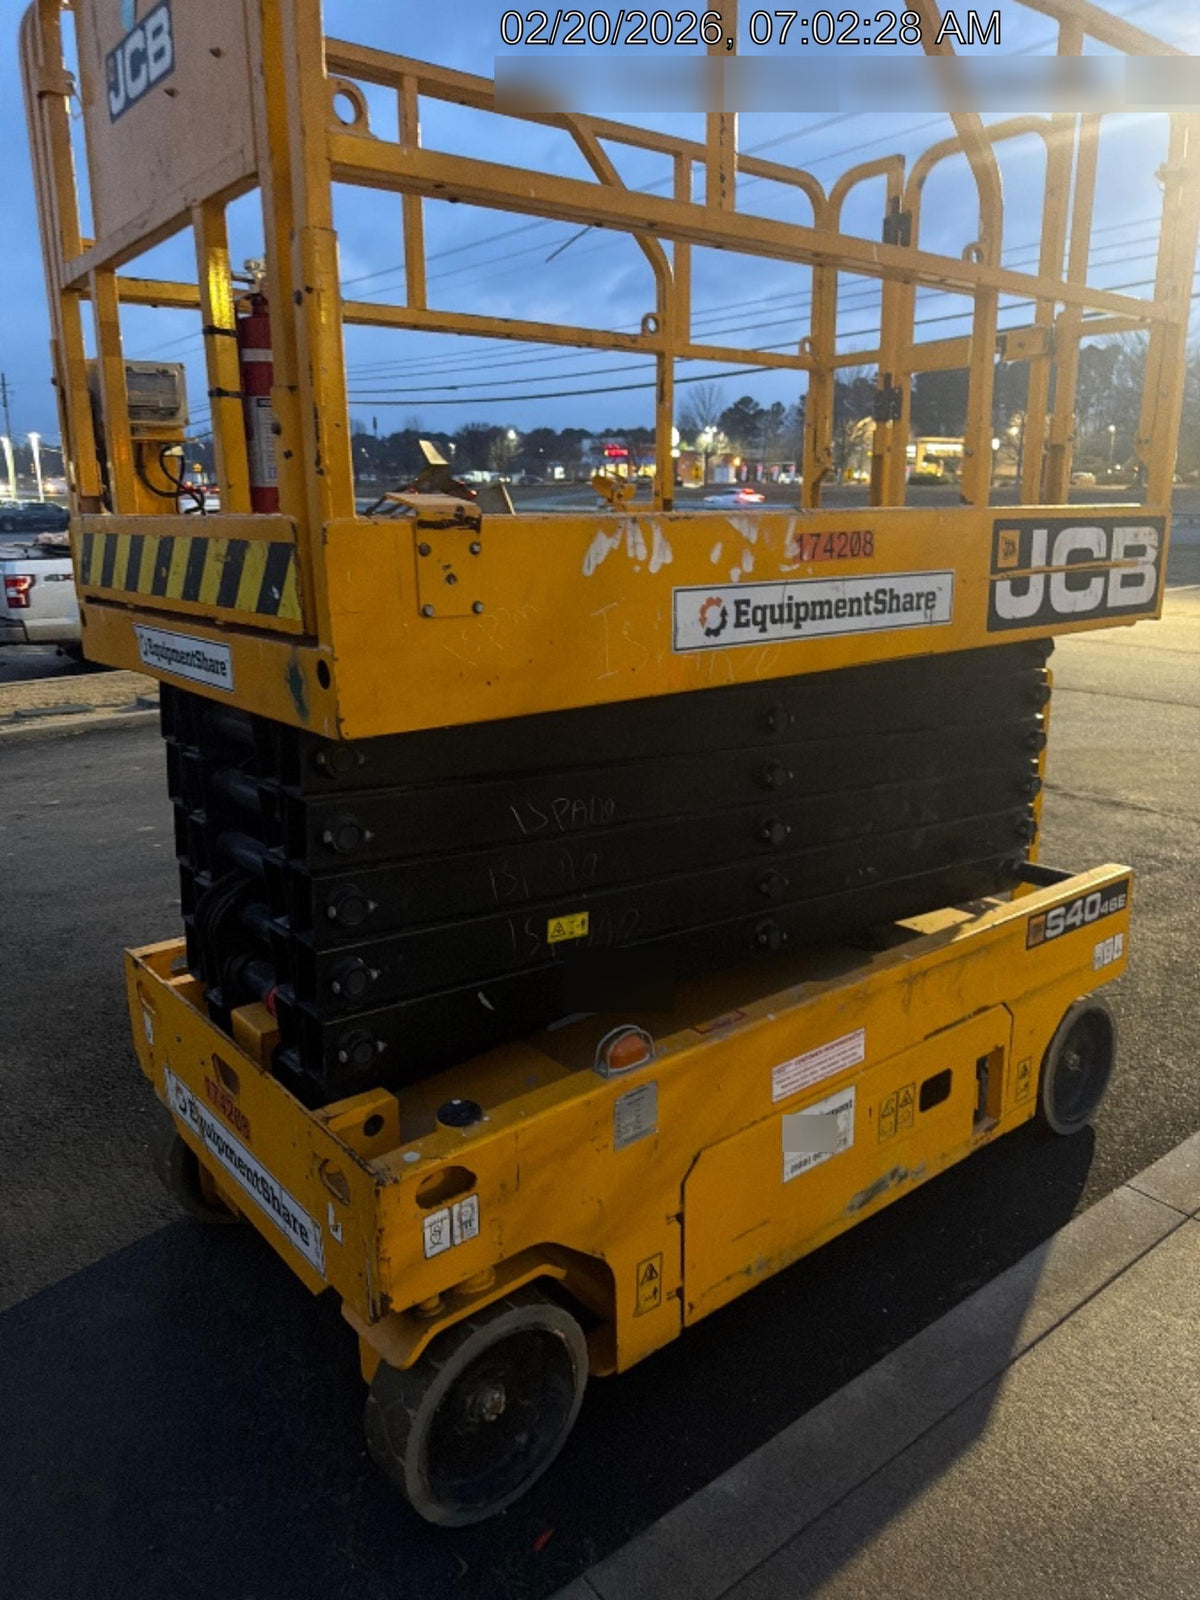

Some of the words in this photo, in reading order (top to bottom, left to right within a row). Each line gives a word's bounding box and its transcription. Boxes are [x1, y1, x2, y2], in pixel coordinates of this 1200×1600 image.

[109, 6, 172, 114] JCB
[797, 530, 874, 560] 174208
[995, 526, 1159, 620] JCB
[733, 587, 937, 634] EquipmentShare
[147, 638, 227, 677] EquipmentShare
[188, 1098, 311, 1248] EquipmentShare
